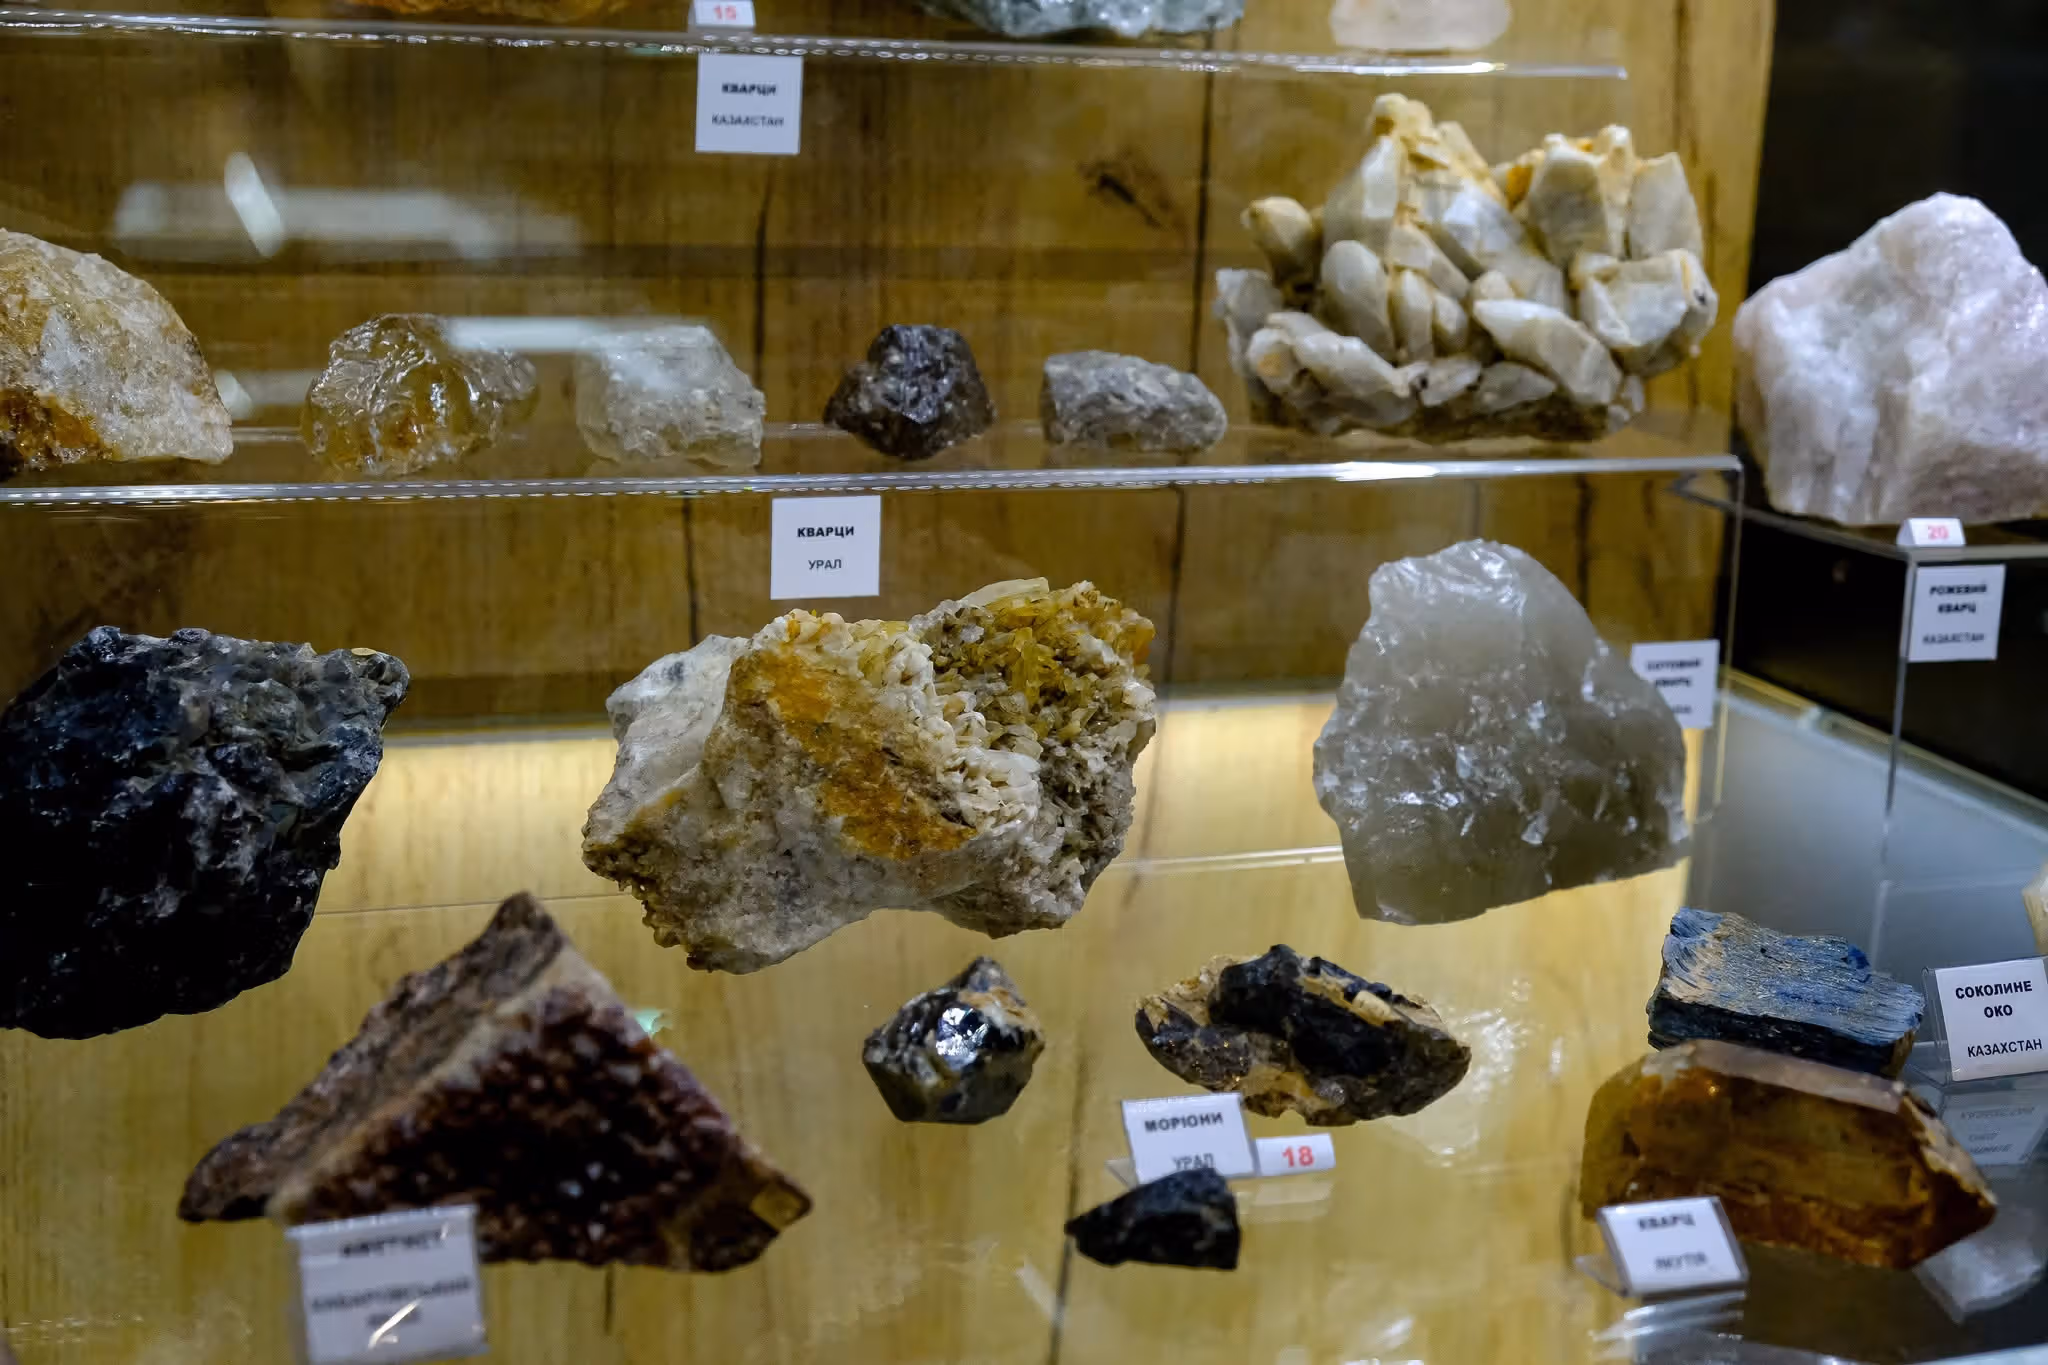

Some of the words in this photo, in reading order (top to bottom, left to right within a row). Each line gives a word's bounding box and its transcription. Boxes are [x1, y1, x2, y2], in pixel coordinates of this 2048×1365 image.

[721, 83, 777, 95] КВАРЦИ
[797, 526, 854, 538] КВАРЦИ
[808, 559, 842, 570] УРАЛ
[1938, 602, 1976, 614] КВАРЦ
[1955, 980, 2032, 999] СОКОЛИНЕ
[1984, 1004, 2013, 1018] ОКО
[1967, 1038, 2042, 1058] КАЗАХСТАН
[1144, 1111, 1223, 1132] МОРІОНИ
[1282, 1146, 1314, 1167] 18
[1638, 1213, 1696, 1231] КВАРЦ
